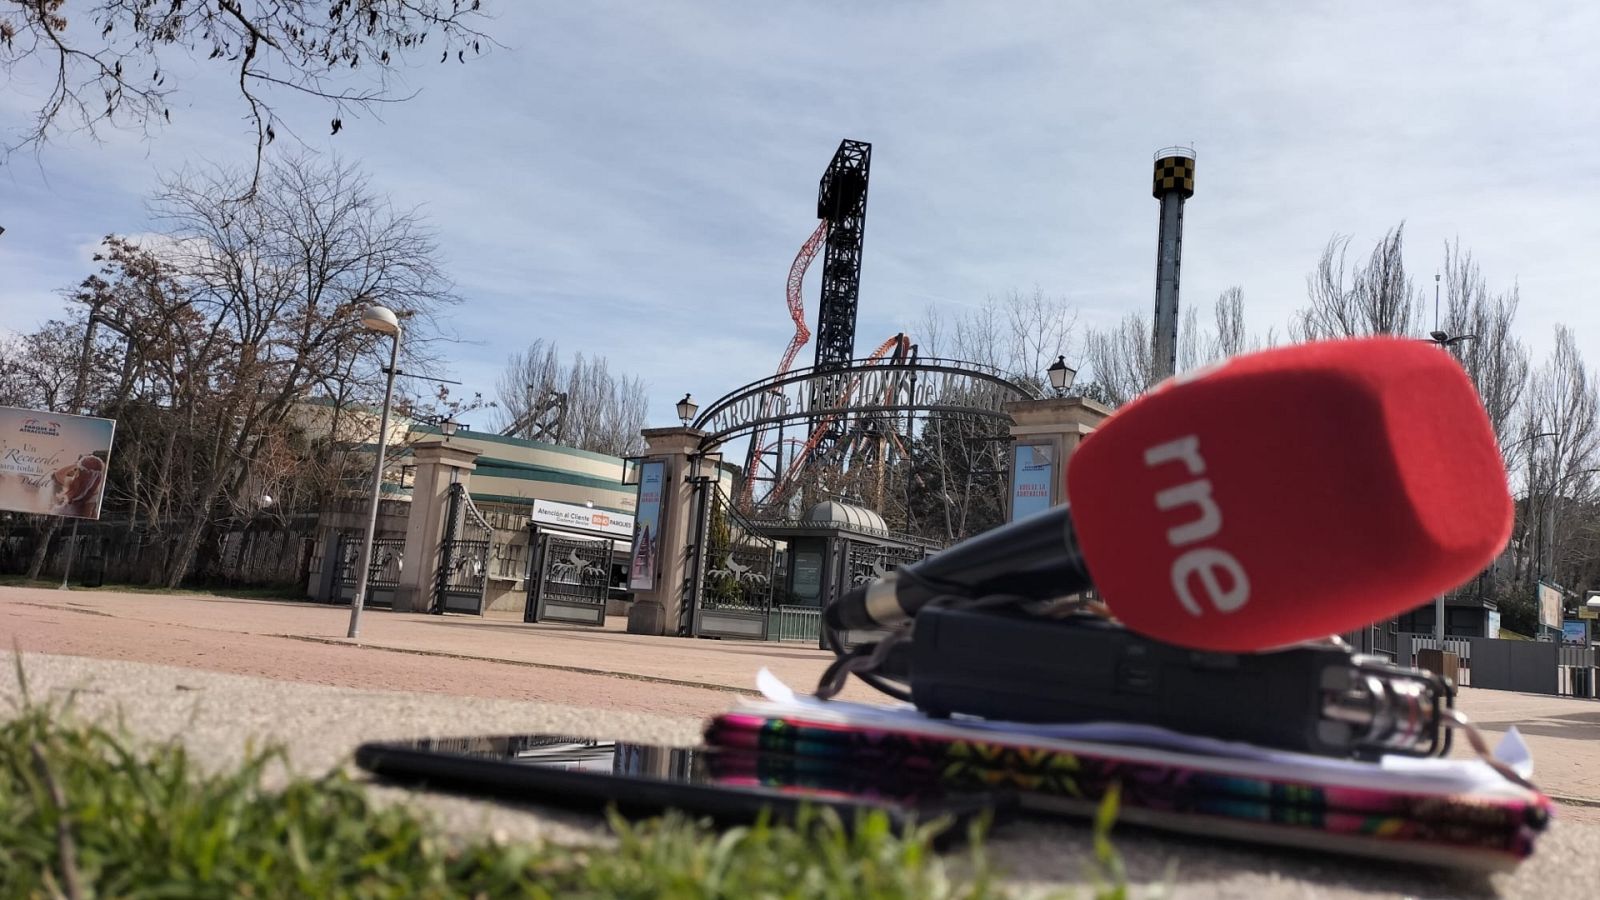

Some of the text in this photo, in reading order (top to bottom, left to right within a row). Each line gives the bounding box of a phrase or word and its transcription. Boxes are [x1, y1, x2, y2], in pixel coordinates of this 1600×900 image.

[775, 394, 791, 418] de
[915, 371, 935, 406] de
[23, 443, 37, 452] Un
[16, 464, 34, 473] toda
[537, 507, 563, 517] Atención
[570, 512, 590, 522] Cliente
[609, 519, 632, 529] PARQUES
[1143, 433, 1251, 618] rne
